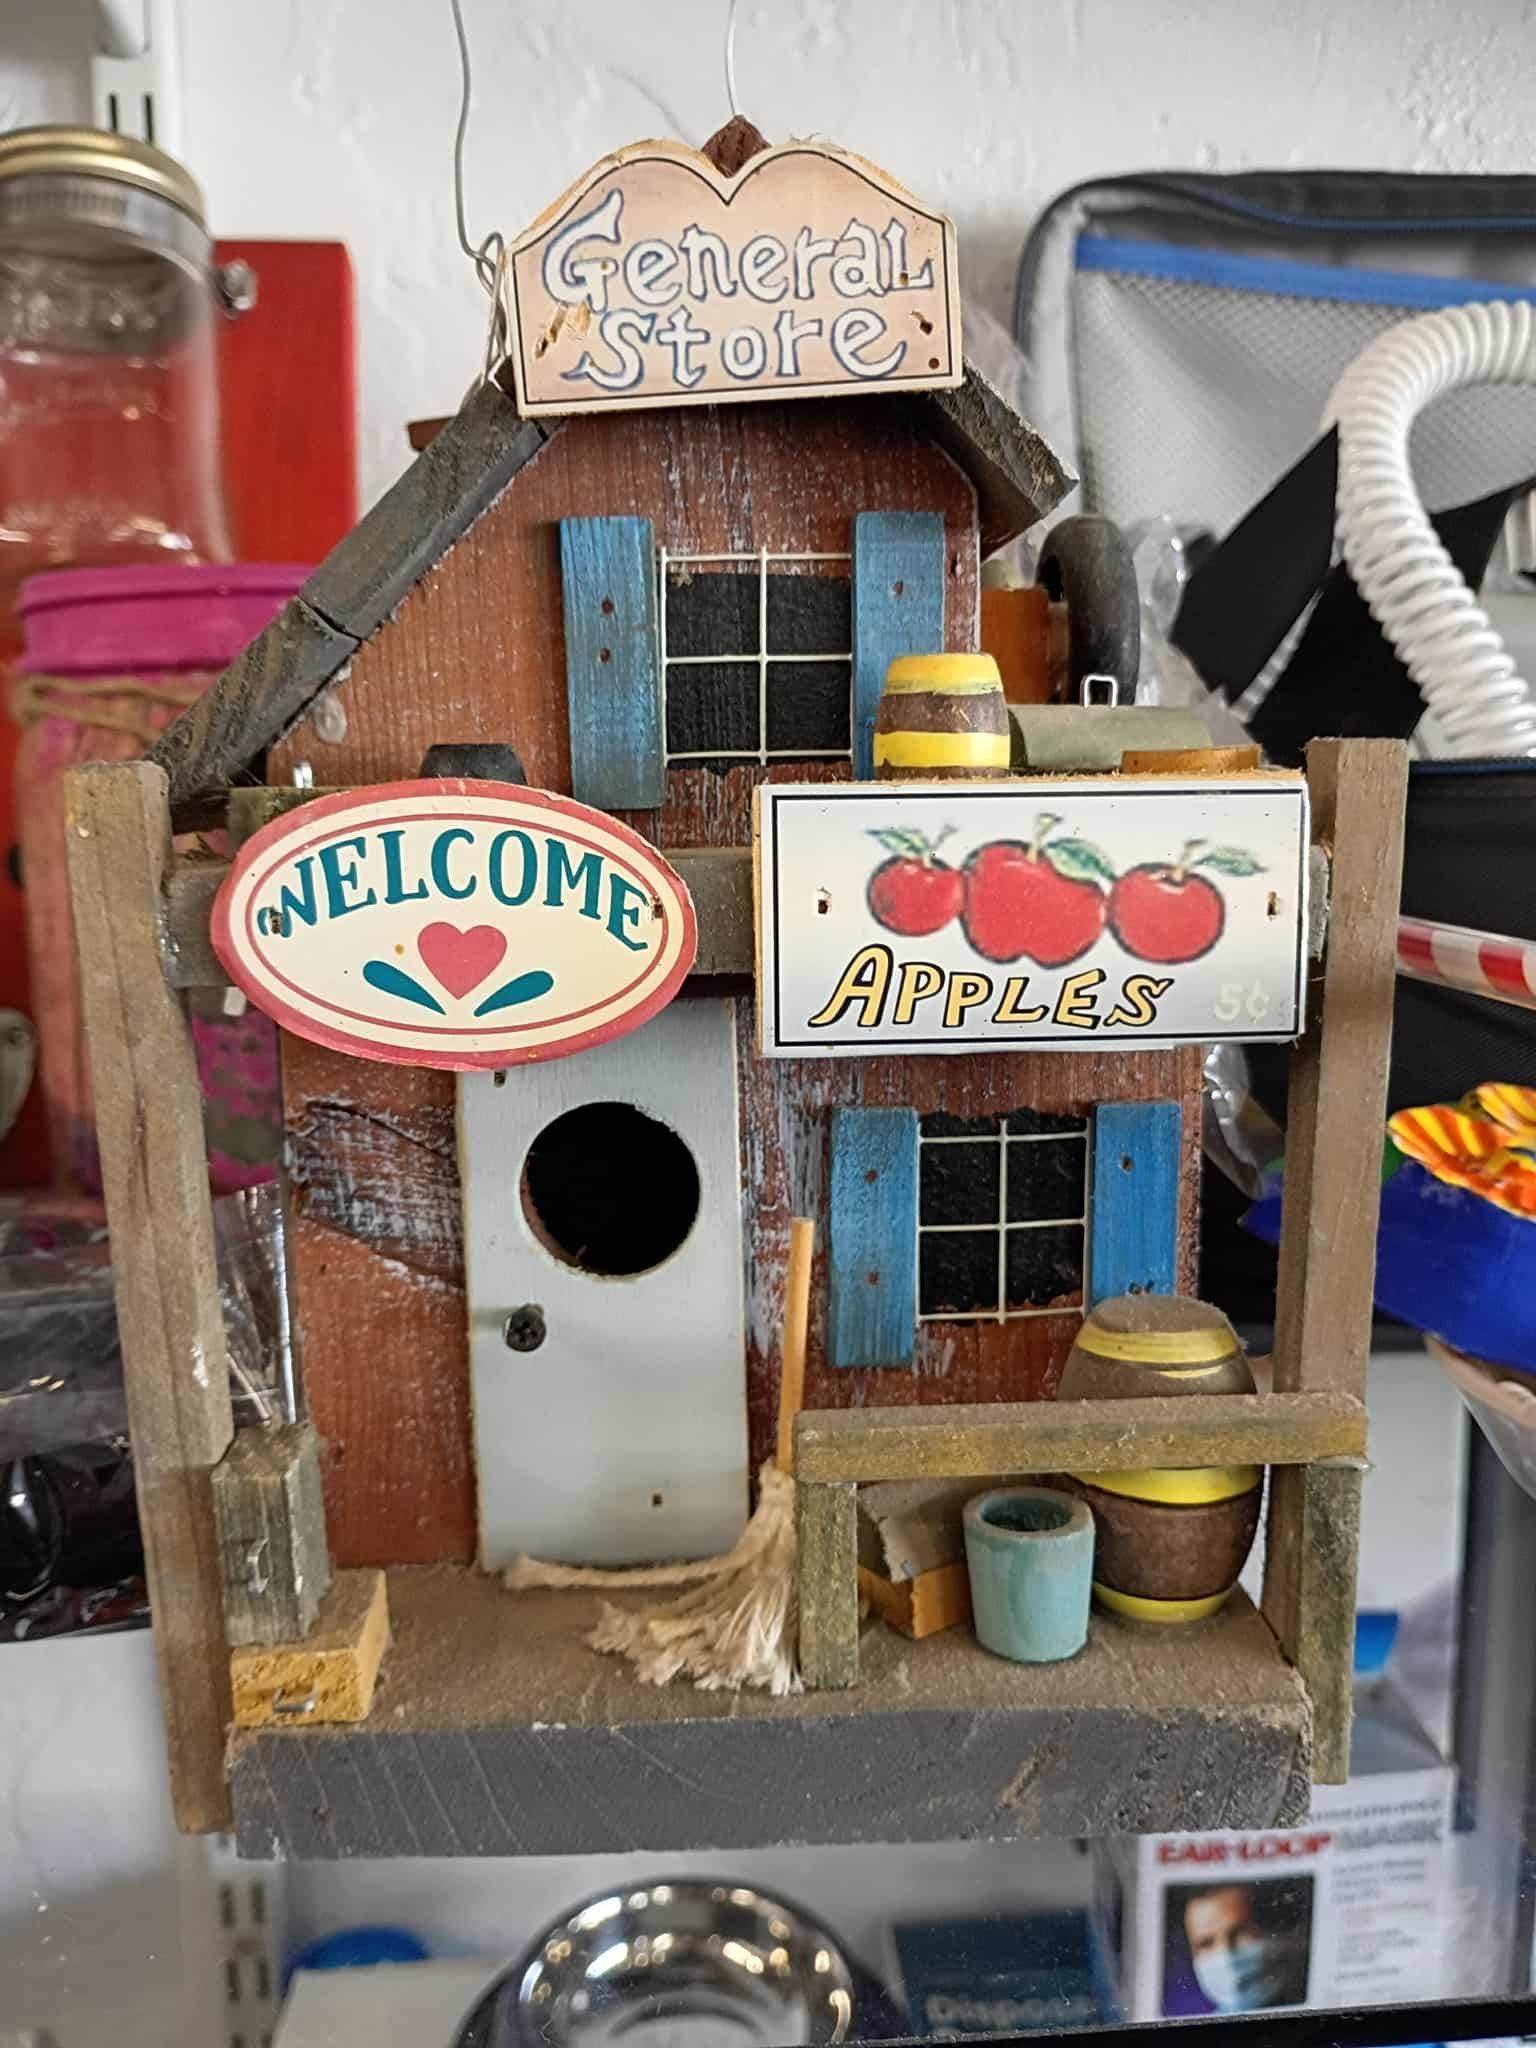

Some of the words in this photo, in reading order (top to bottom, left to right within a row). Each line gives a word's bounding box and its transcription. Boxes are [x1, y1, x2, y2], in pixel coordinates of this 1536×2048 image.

[560, 305, 907, 390] Store
[257, 828, 654, 952] WELCOME
[808, 943, 1175, 1030] APPLES
